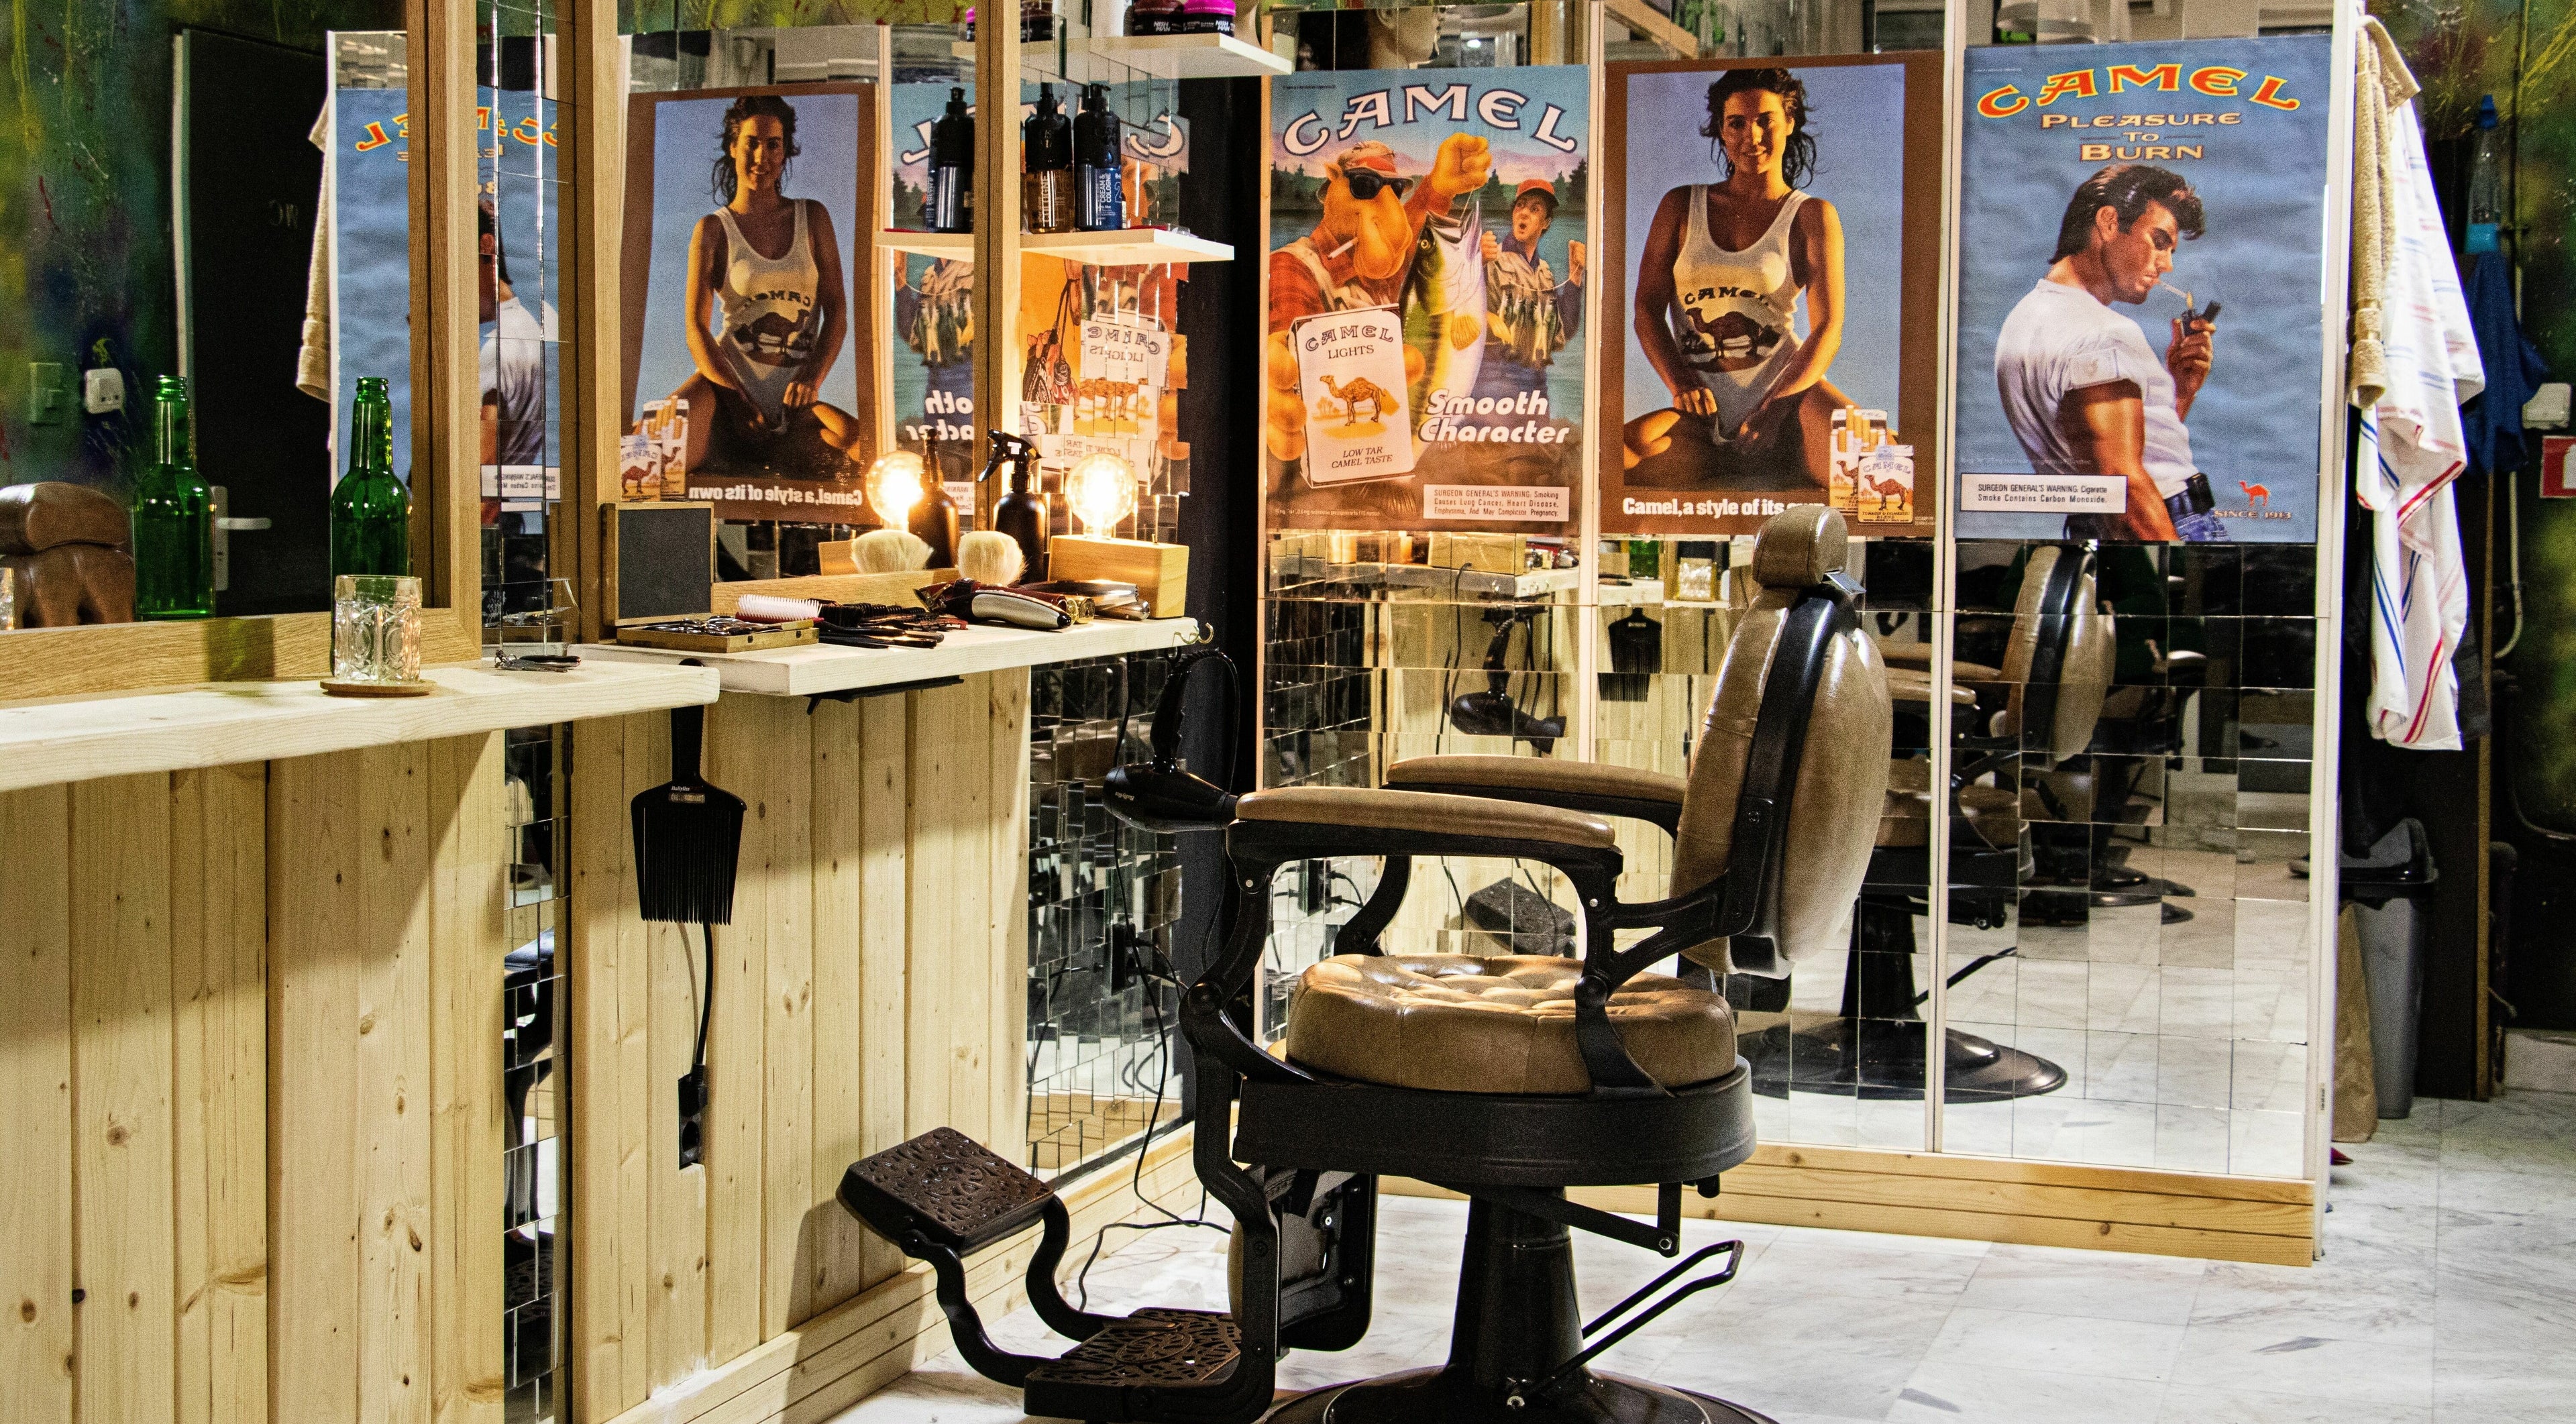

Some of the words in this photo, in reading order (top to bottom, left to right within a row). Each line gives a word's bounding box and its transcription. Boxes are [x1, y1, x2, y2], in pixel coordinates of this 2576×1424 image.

[1976, 64, 2301, 119] CAMEL
[1282, 83, 1578, 156] CAMEL
[2041, 112, 2242, 130] PLEASURE
[2080, 144, 2204, 162] BURN
[1305, 324, 1393, 352] CAMEL
[1328, 345, 1375, 360] LIGHTS
[1426, 387, 1548, 417] Smooth
[1417, 417, 1570, 444] Character
[1342, 447, 1366, 458] LOW
[1368, 445, 1383, 455] TAR
[1331, 457, 1362, 469] CAMEL
[1364, 454, 1393, 464] TASTE
[1863, 461, 1912, 474] CAMEL
[1434, 489, 1463, 497] SURGEON
[1466, 490, 1499, 498] GENERAL'S
[1534, 490, 1559, 500] Smoking
[1979, 484, 2007, 492] SURGEON
[2010, 484, 2044, 492] GENERAL'S
[2081, 485, 2107, 494] Cigarette
[1460, 498, 1475, 507] Lung
[2070, 495, 2107, 503] Monoxide.
[1623, 498, 1682, 517] Camel,
[1683, 503, 1694, 514] a
[1696, 499, 1738, 518] style
[1741, 499, 1760, 514] of
[1761, 498, 1784, 514] its
[2214, 510, 2259, 518] SINCE
[2263, 511, 2292, 520] 1913
